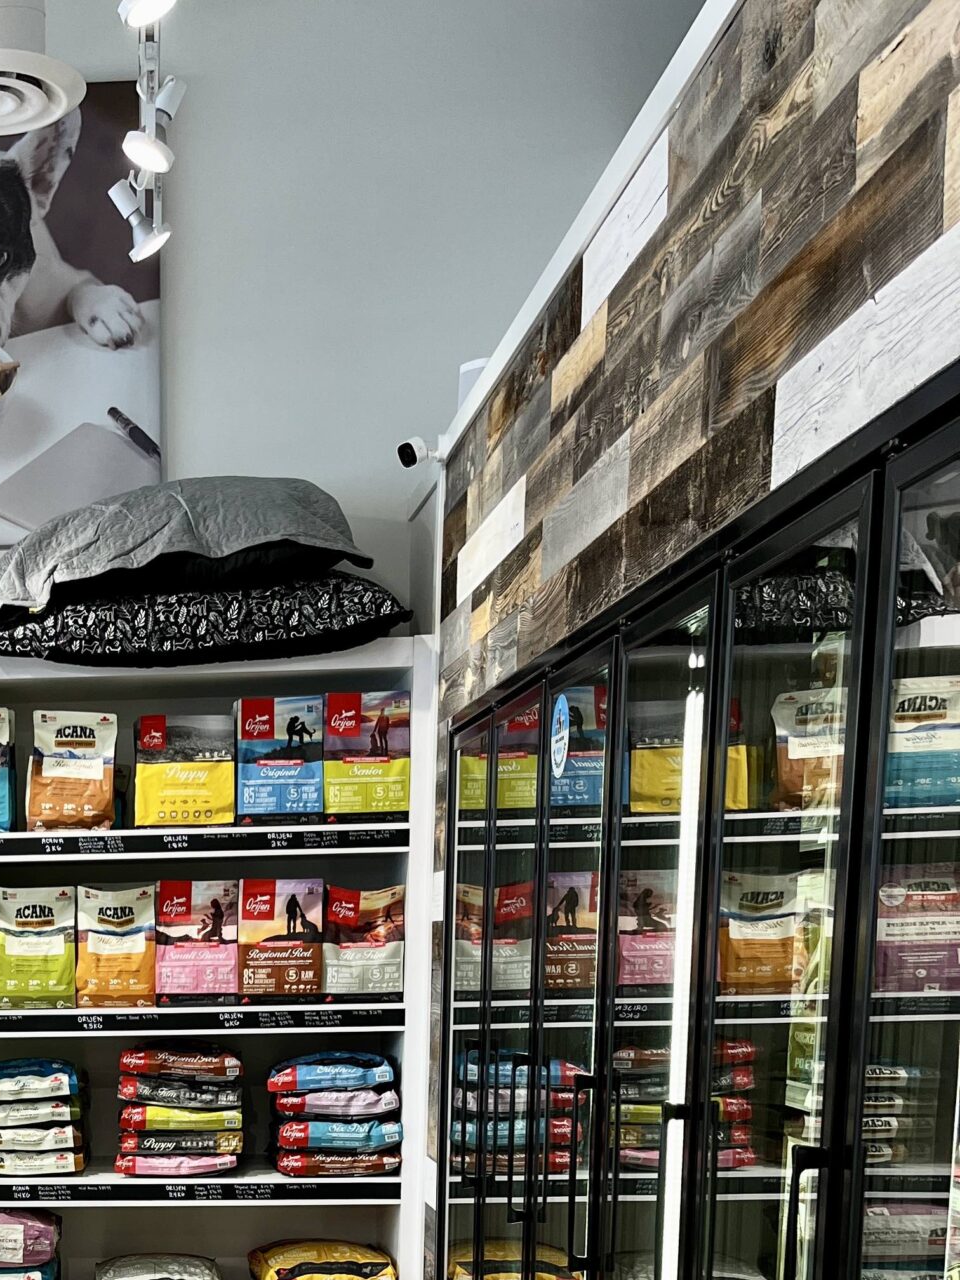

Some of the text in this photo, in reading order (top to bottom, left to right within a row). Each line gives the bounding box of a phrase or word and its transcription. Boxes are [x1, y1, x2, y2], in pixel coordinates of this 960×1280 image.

[245, 720, 270, 735] Orijen
[331, 713, 356, 731] Orijen
[55, 726, 96, 739] ACANA
[164, 767, 210, 782] Puppy
[260, 767, 300, 777] Original
[349, 765, 383, 776] Senior
[243, 786, 254, 804] 85
[329, 786, 340, 804] 85
[15, 905, 54, 918] ACANA
[98, 906, 135, 919] ACANA
[163, 901, 186, 917] Orijen
[246, 899, 270, 915] Orijen
[332, 901, 355, 917] Orijen
[247, 948, 312, 961] Regional Red
[243, 968, 254, 984] 85
[301, 971, 315, 979] RAW
[123, 1055, 145, 1068] Orijen
[283, 1127, 305, 1142] Orijen
[141, 1138, 176, 1151] Puppy
